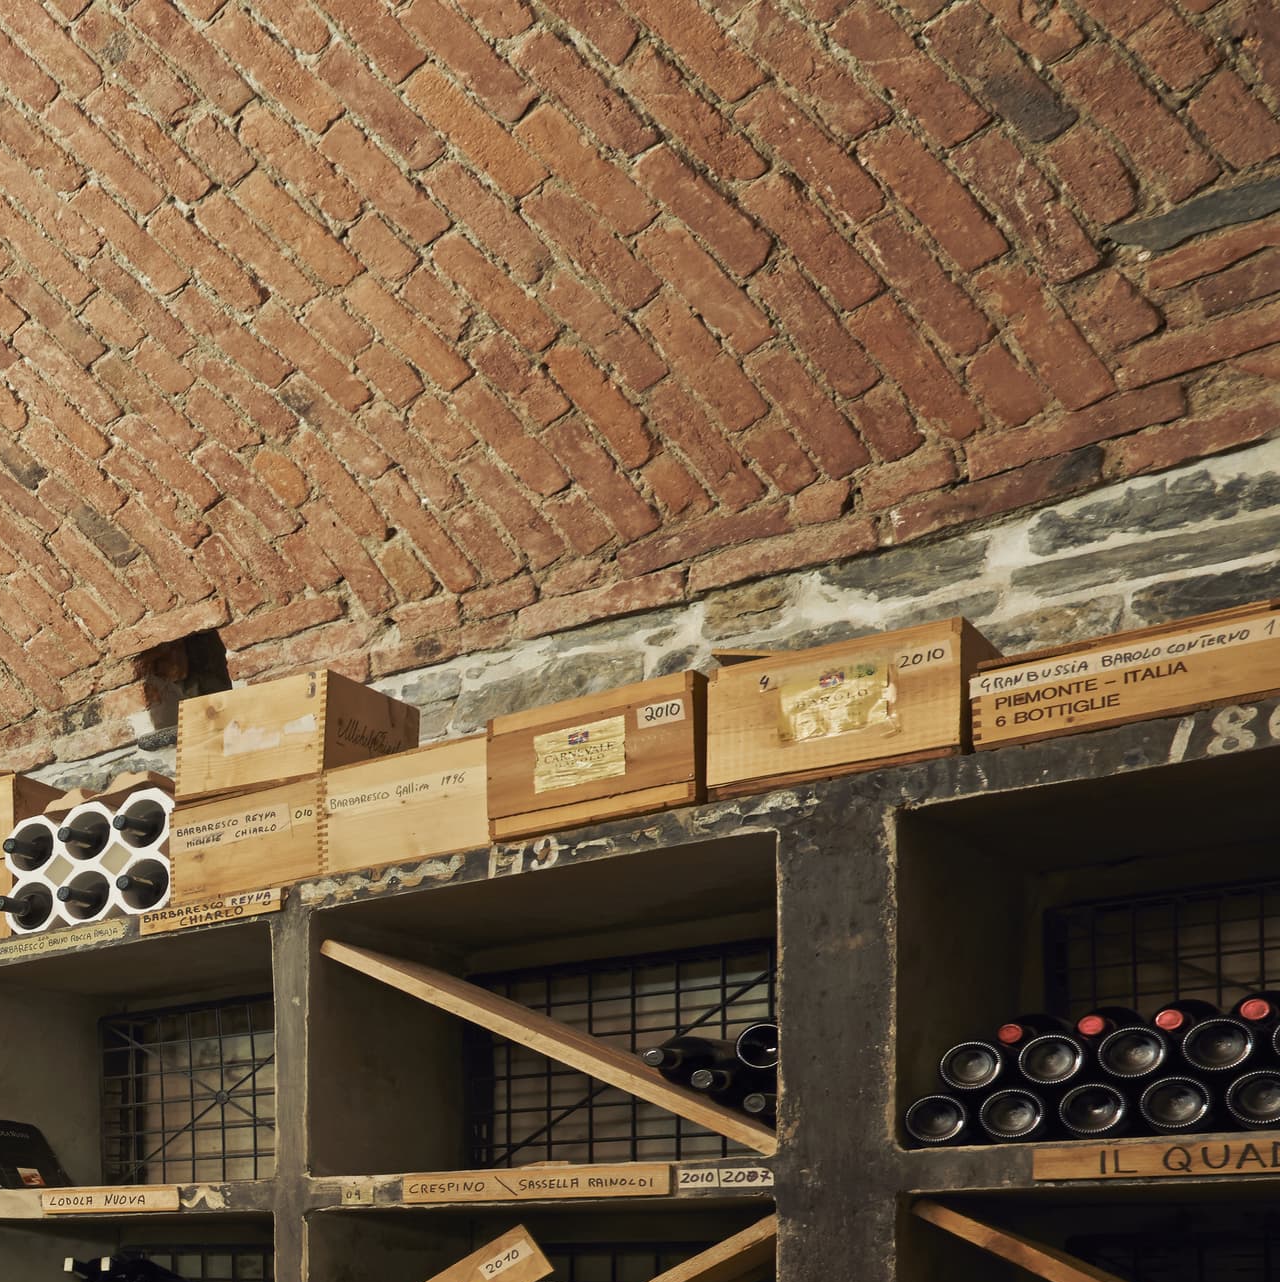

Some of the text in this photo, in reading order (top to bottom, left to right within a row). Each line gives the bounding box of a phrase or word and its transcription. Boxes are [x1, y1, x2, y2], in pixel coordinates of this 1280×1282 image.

[899, 648, 945, 668] 2010
[1101, 646, 1160, 669] BAROLO
[995, 661, 1188, 710] PIEMONTE ITALIA
[644, 703, 681, 721] 2010
[995, 693, 1121, 728] 6 BOTTIGLIE
[330, 791, 390, 810] BARBARESCO
[143, 901, 224, 923] BARBARESCO
[178, 905, 244, 927] CHIARLO
[1099, 1150, 1138, 1176] IL
[409, 1180, 486, 1194] CRESPINO
[518, 1177, 579, 1191] SASSELLA
[680, 1171, 715, 1184] 2010
[49, 1193, 146, 1208] LODOLA NUOVA
[485, 1249, 520, 1275] 2010
